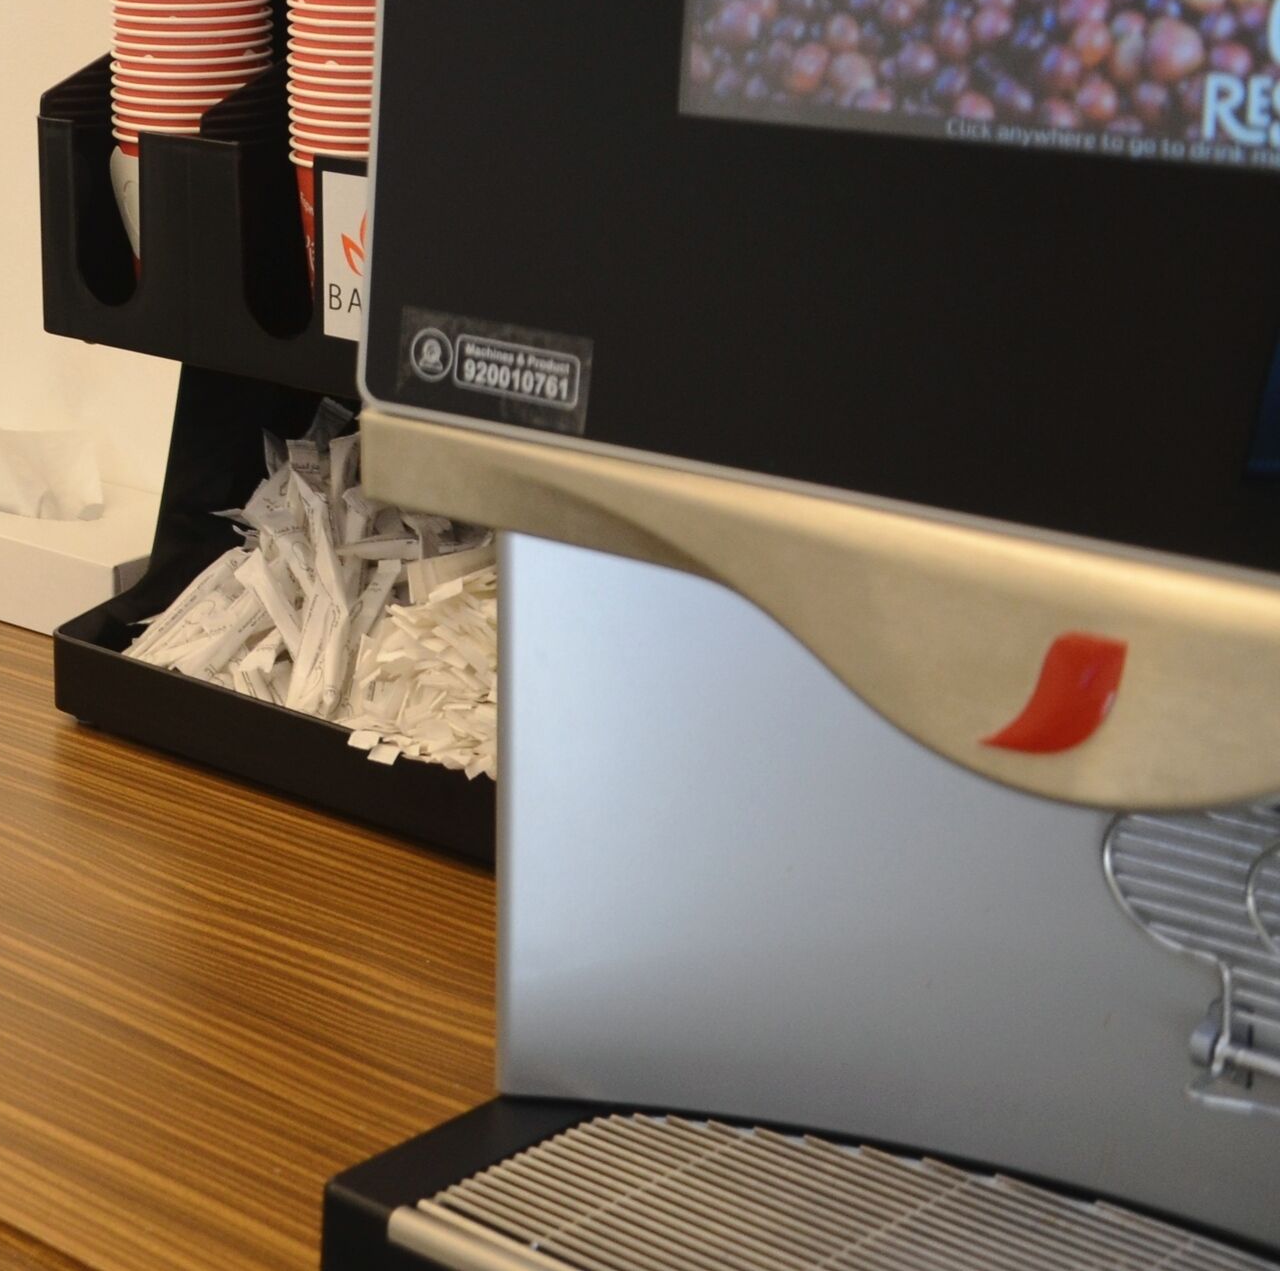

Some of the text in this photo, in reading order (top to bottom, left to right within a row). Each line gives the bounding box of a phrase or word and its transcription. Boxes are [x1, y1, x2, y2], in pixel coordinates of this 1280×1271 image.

[945, 117, 991, 140] Click
[997, 125, 1097, 149] anywhere
[328, 282, 362, 313] BA
[463, 358, 569, 401] 920010761
